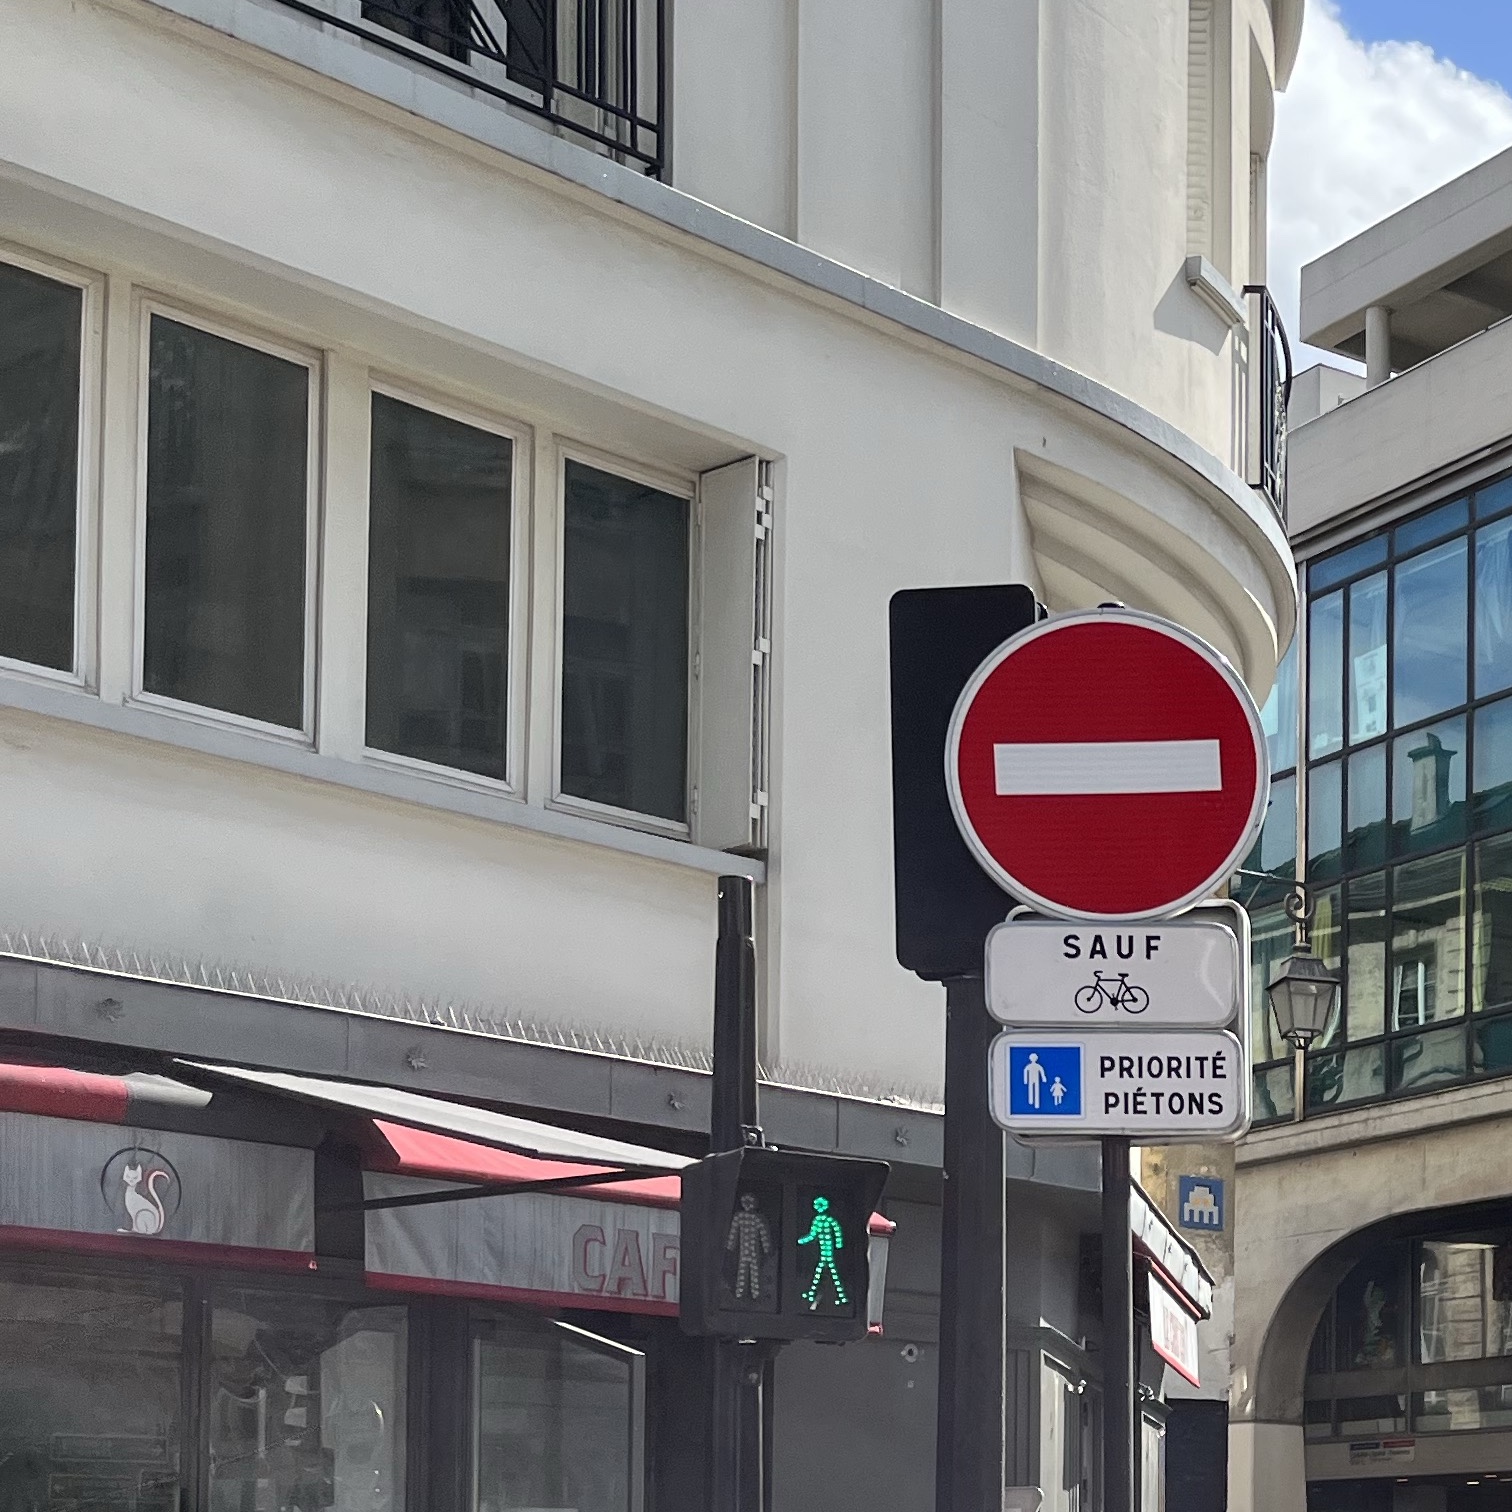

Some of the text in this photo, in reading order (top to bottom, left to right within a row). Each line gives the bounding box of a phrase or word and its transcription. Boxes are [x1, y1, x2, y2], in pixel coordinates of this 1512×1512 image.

[1062, 933, 1162, 961] SAUF
[1099, 1050, 1228, 1080] PRIORITÉ
[1103, 1086, 1225, 1116] PIÉTONS
[572, 1222, 681, 1299] CAF
